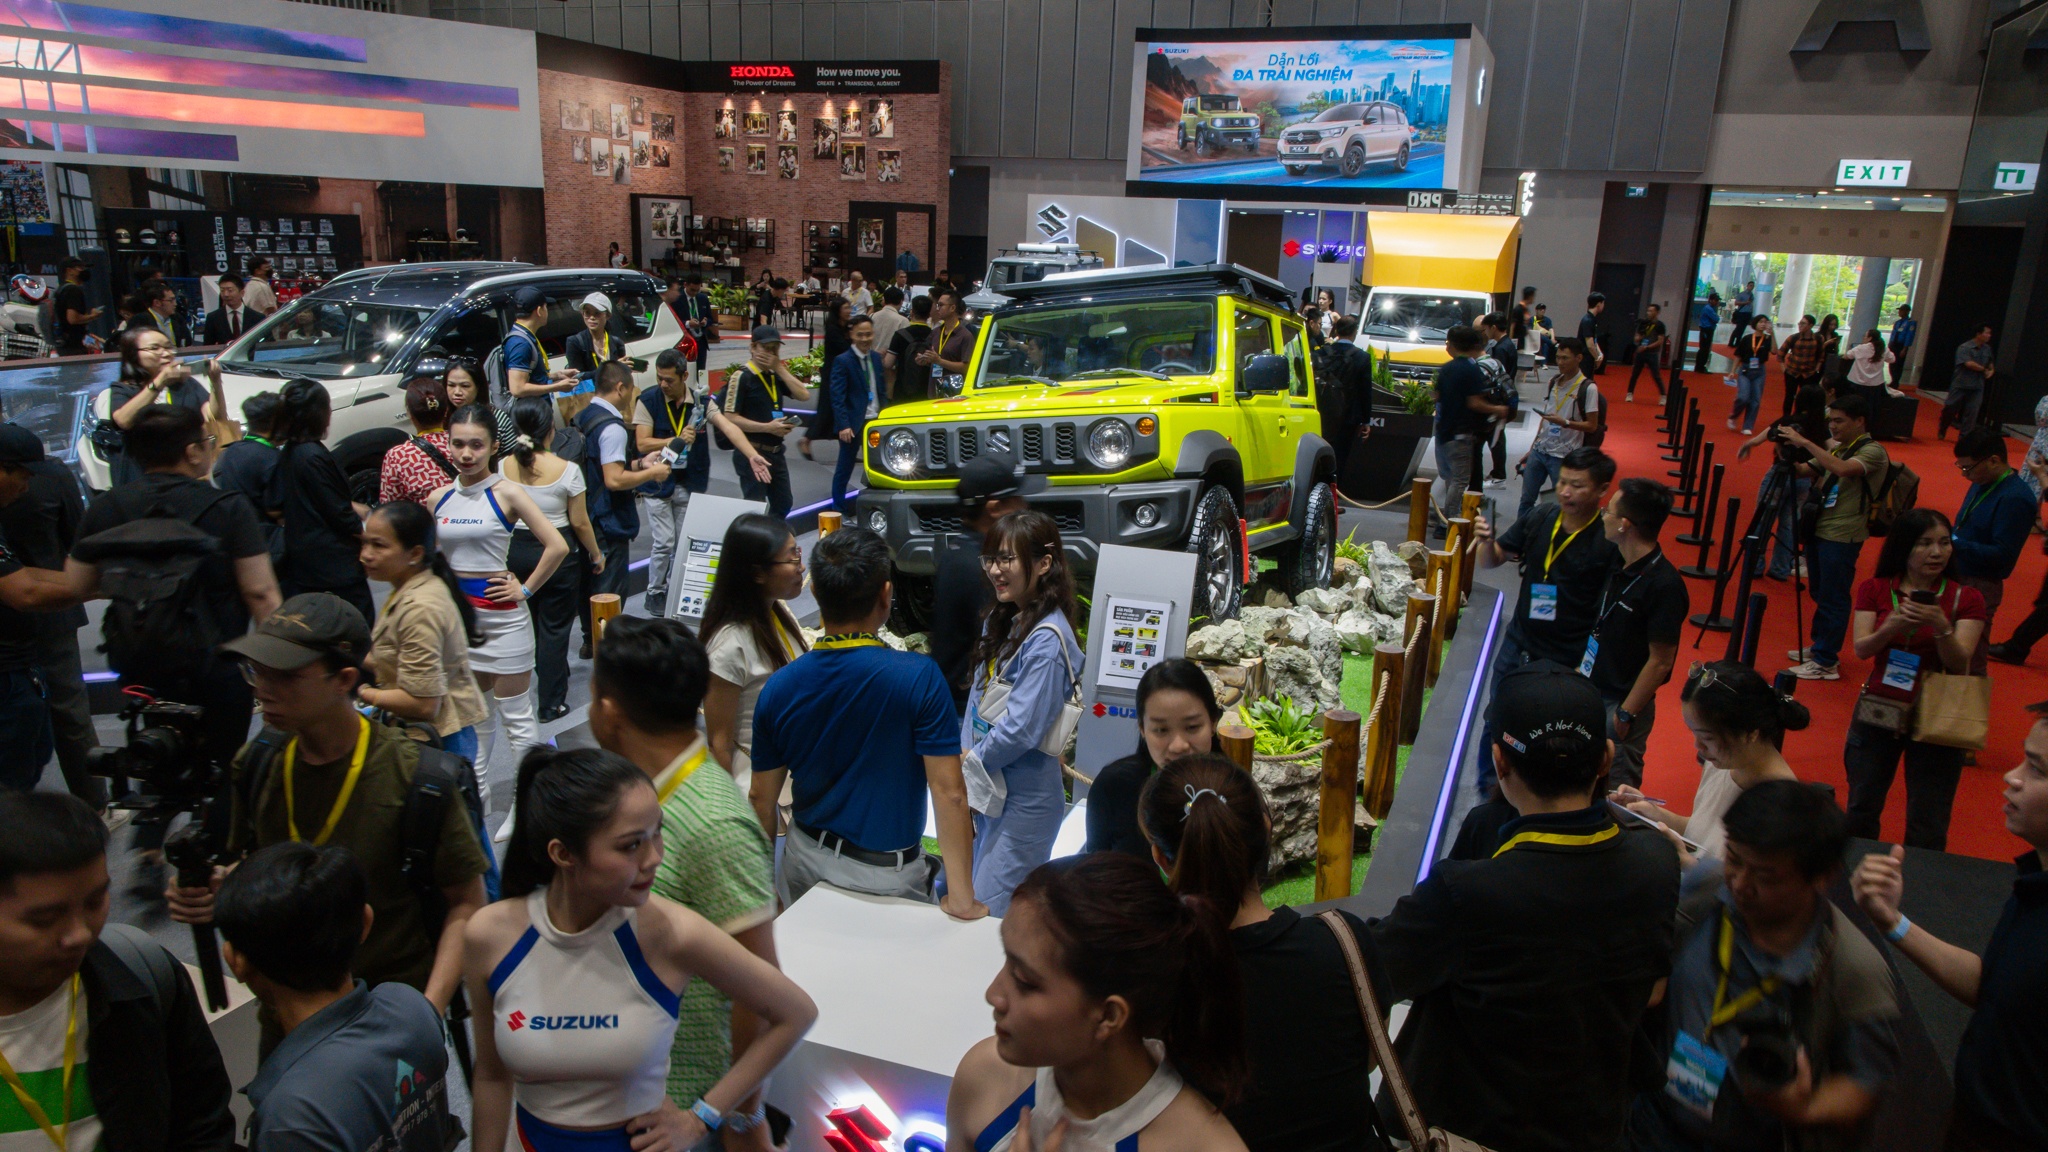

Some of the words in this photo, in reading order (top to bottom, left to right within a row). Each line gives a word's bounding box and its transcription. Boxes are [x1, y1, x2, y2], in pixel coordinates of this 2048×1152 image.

[1298, 52, 1320, 66] Lối
[731, 66, 794, 77] HONDA
[816, 67, 838, 77] How
[839, 69, 854, 77] we
[854, 69, 880, 77] move
[881, 69, 901, 79] you.
[1232, 68, 1254, 81] ĐA
[1258, 66, 1291, 81] TRẢI
[1293, 66, 1353, 84] NGHIỆM
[1843, 165, 1904, 181] EXIT
[216, 251, 228, 272] CB
[1108, 706, 1137, 719] SUZ
[1529, 729, 1543, 739] We
[1545, 723, 1553, 732] R
[1555, 720, 1573, 730] Not
[1574, 723, 1592, 740] Alone
[529, 1014, 619, 1030] SUZUKI
